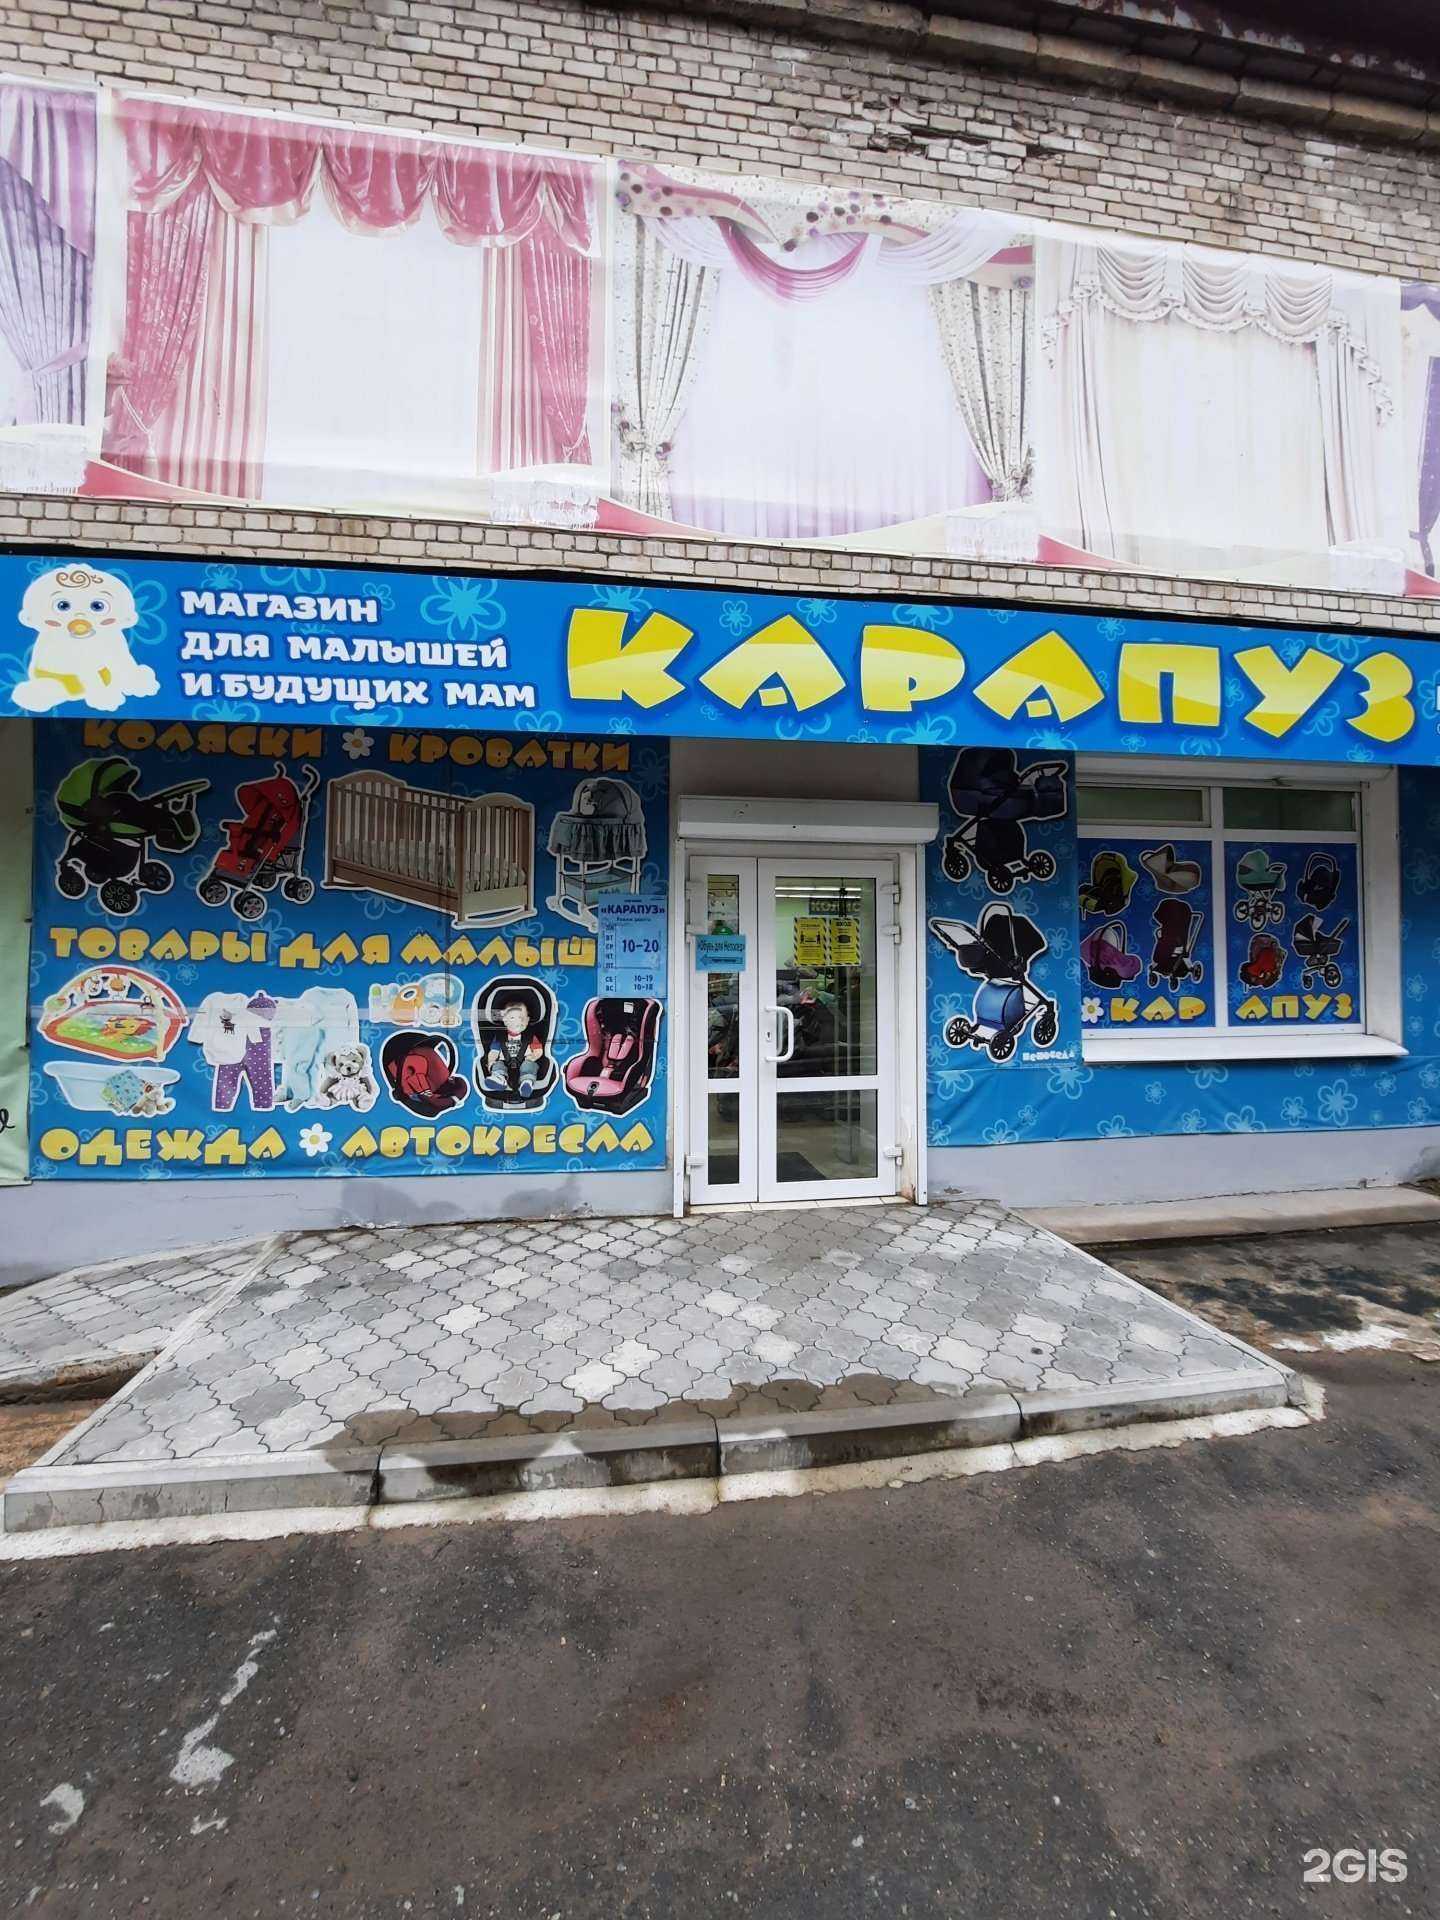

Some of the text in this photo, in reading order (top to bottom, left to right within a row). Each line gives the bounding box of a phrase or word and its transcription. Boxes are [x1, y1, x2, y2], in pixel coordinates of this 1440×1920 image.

[181, 590, 377, 623] МАГАЗИН
[181, 631, 507, 668] ДЛЯ МАЛЫШЕЙ
[181, 672, 535, 711] И БУДУЩИХ МАМ
[566, 607, 1415, 742] КАРАПУЗ
[84, 720, 630, 772] КОЛЯСКИ КРОВАТКИ
[50, 927, 267, 963] ТОВАРЫ
[279, 932, 390, 968] ДЛЯ
[622, 938, 660, 953] 10-20
[40, 1121, 654, 1165] ОДЕЖДА АВТОКРЕСЛА
